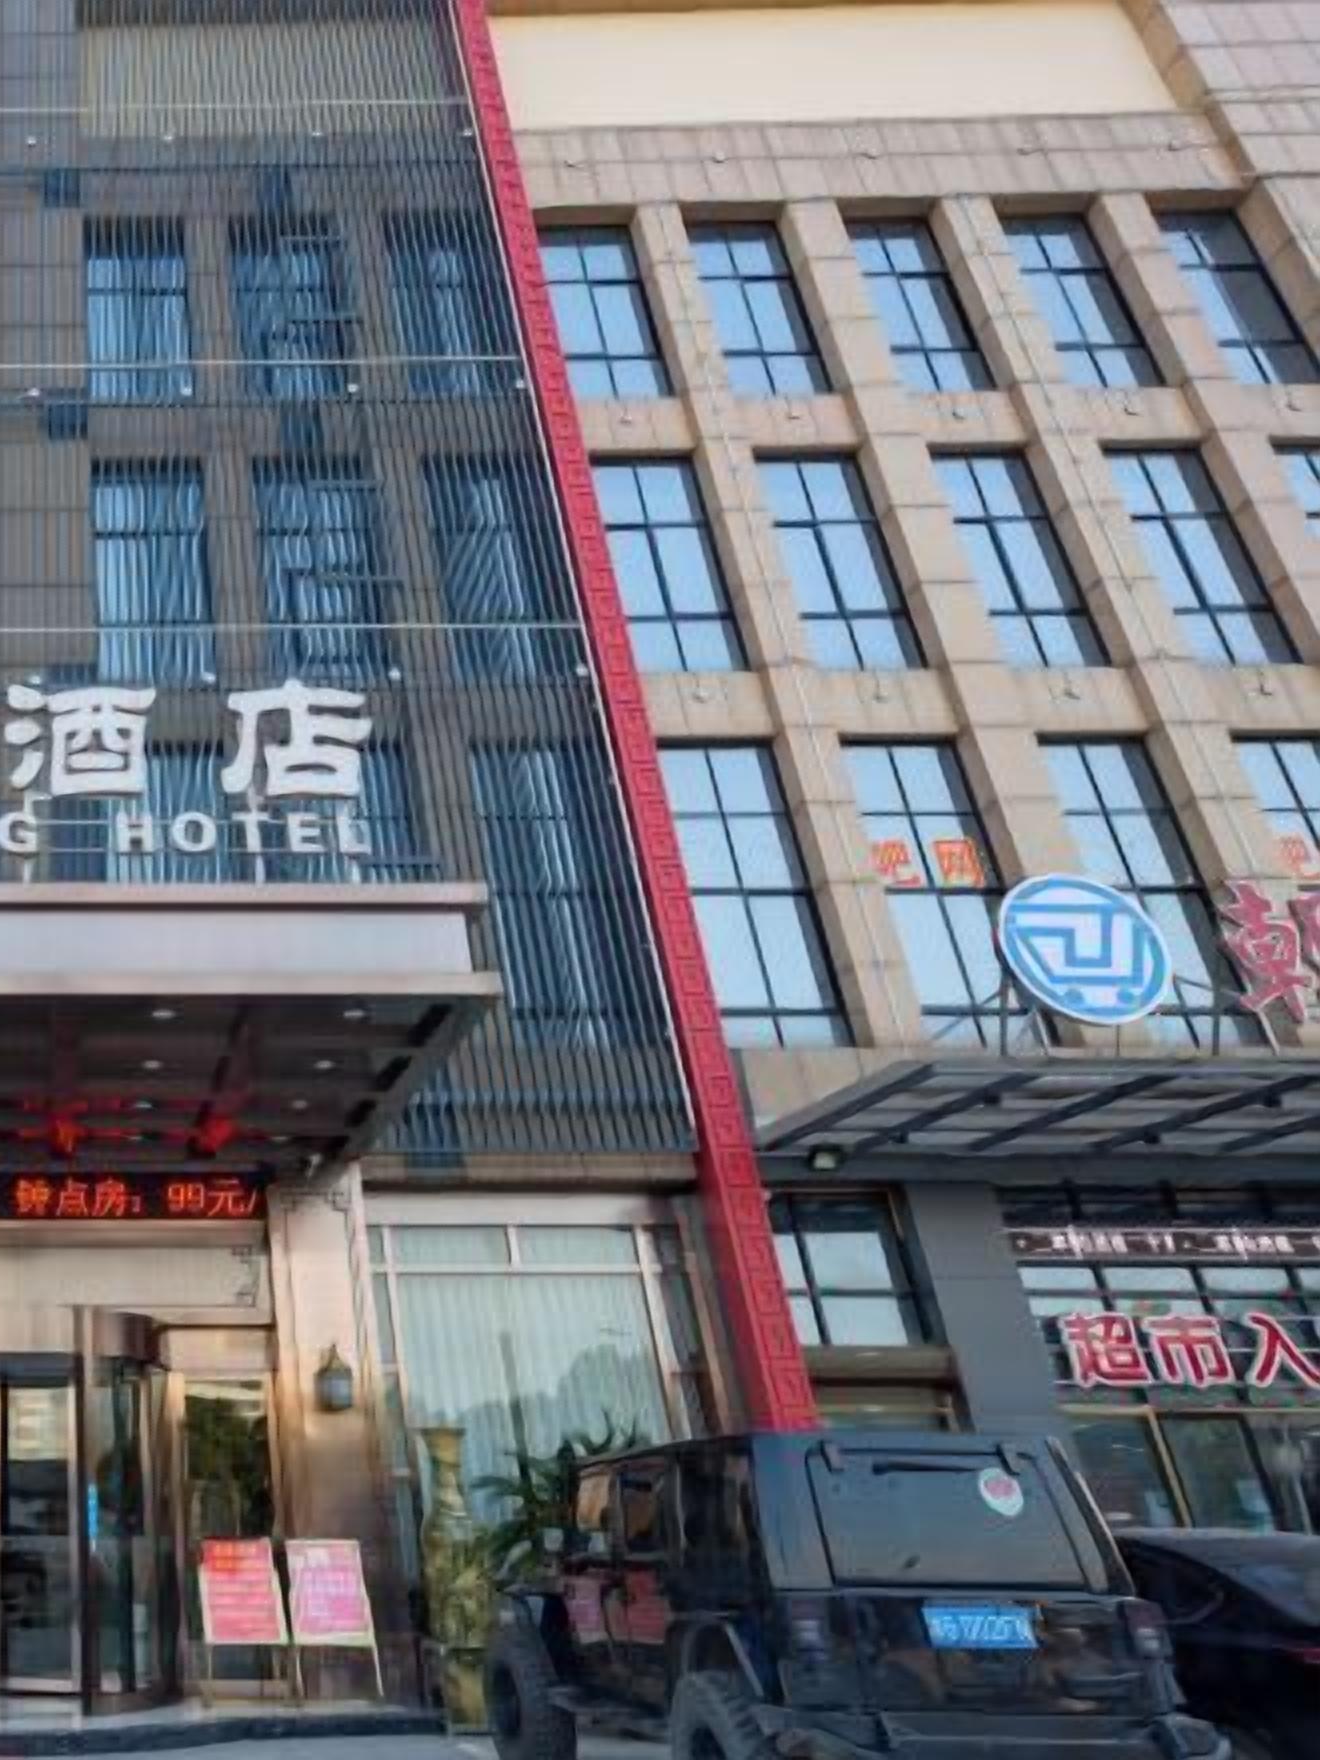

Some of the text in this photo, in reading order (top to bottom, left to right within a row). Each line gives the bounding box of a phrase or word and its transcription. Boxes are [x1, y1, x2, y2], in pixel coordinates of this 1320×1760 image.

[115, 810, 372, 855] HOTEL
[1056, 1311, 1320, 1388] 超市入
